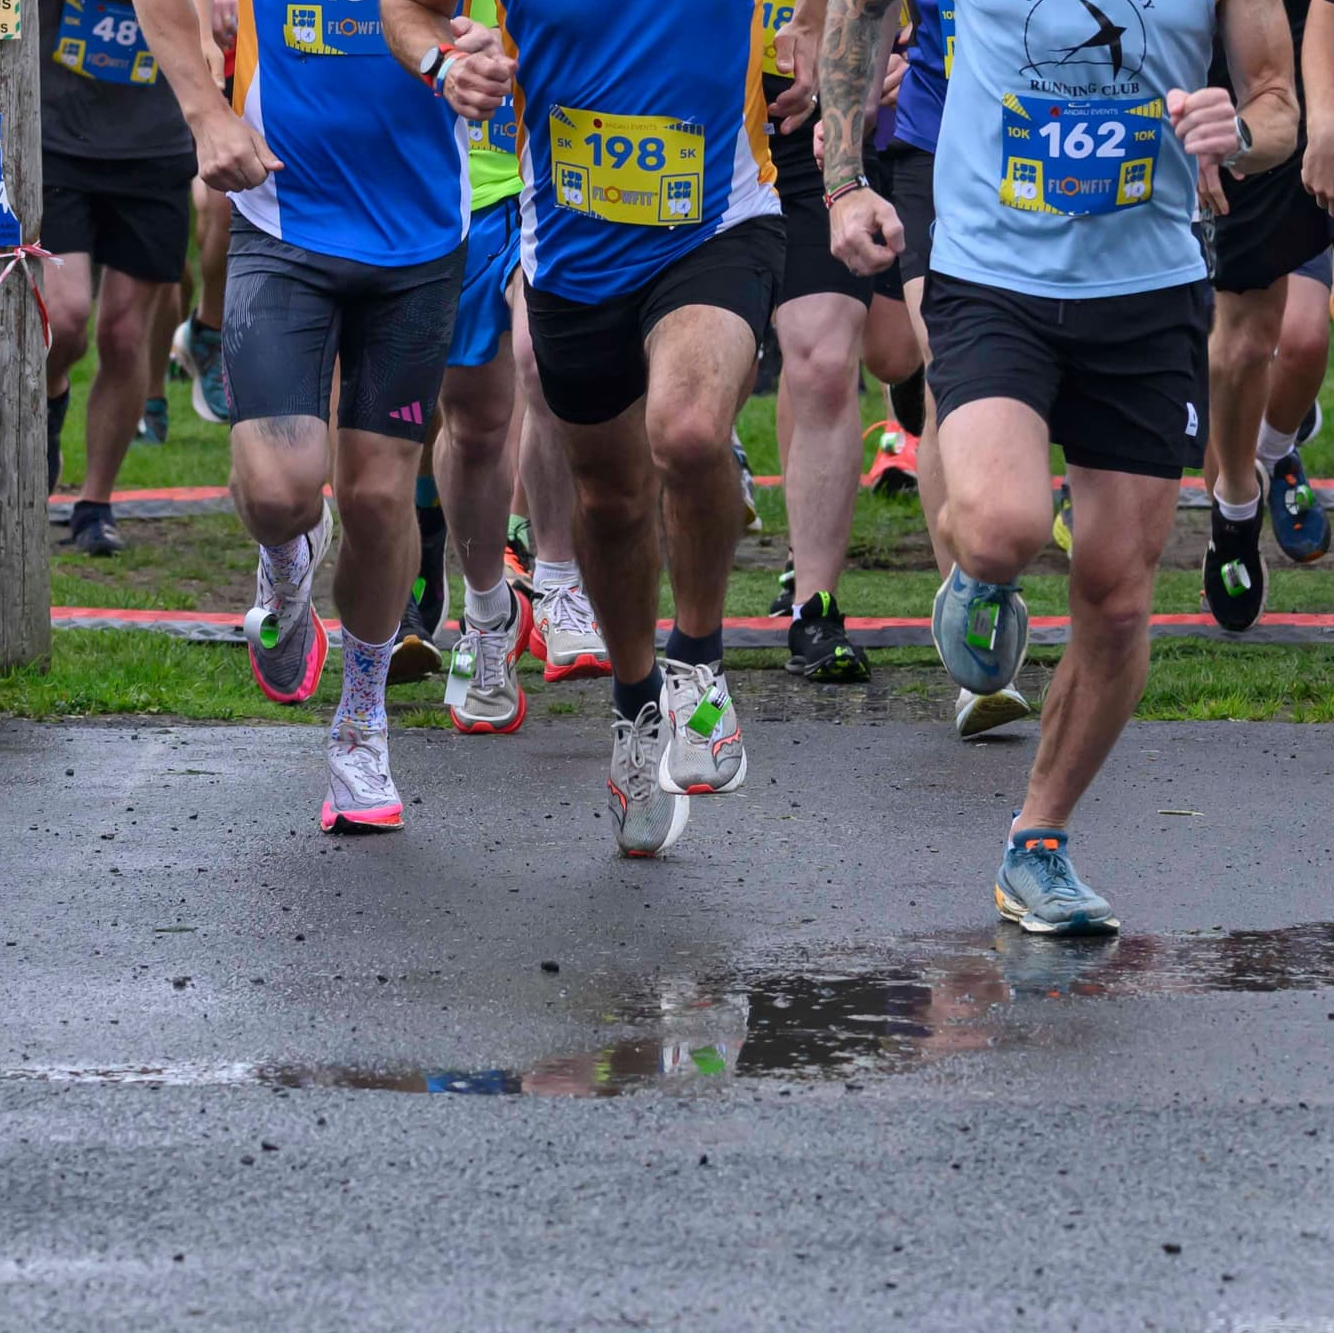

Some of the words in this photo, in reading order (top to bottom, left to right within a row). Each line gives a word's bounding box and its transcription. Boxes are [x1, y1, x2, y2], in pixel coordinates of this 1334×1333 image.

[92, 16, 139, 46] 48
[327, 18, 384, 36] FLOWFI
[1030, 79, 1097, 97] RUNNING
[1101, 82, 1140, 97] CLUB
[1007, 126, 1030, 140] 10K
[1039, 121, 1126, 159] 162
[1134, 130, 1156, 141] 10K
[557, 137, 572, 149] 5K
[584, 132, 666, 172] 198
[680, 148, 696, 159] 5K
[1048, 176, 1112, 196] FLOWFIT
[592, 186, 653, 206] FLOWFIT
